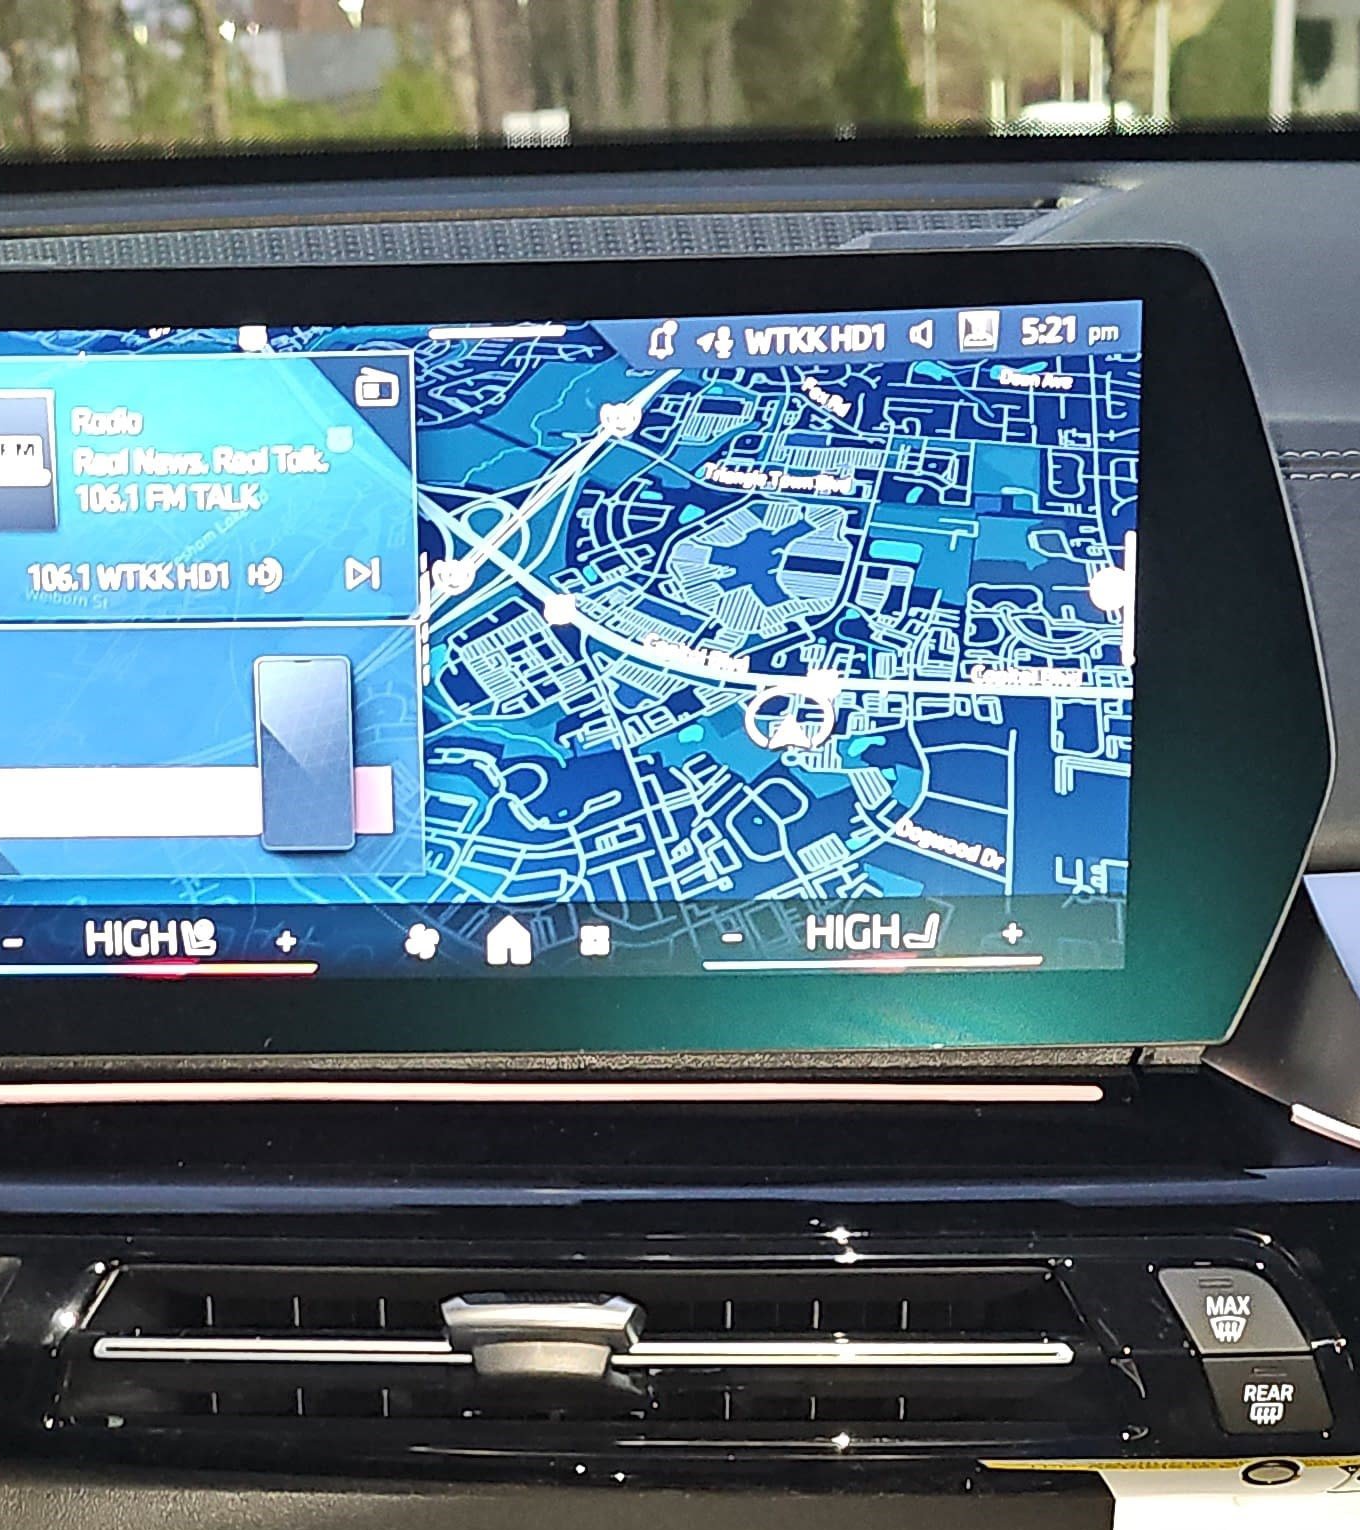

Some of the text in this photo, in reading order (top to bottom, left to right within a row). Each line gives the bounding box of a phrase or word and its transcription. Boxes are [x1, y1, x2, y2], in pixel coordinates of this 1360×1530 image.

[744, 323, 886, 355] WTKK HD1
[1020, 315, 1119, 347] 5:21 pm
[71, 406, 143, 435] Radio
[73, 446, 130, 476] Real
[213, 445, 269, 475] Real
[75, 482, 261, 512] 106.1 FM TALK
[28, 563, 90, 592] 106.1
[97, 563, 174, 591] WTKK
[178, 562, 230, 590] HD1
[86, 918, 181, 957] HIGH
[805, 913, 900, 951] HIGH
[1206, 1295, 1251, 1316] MAX
[1243, 1383, 1294, 1403] REAR
